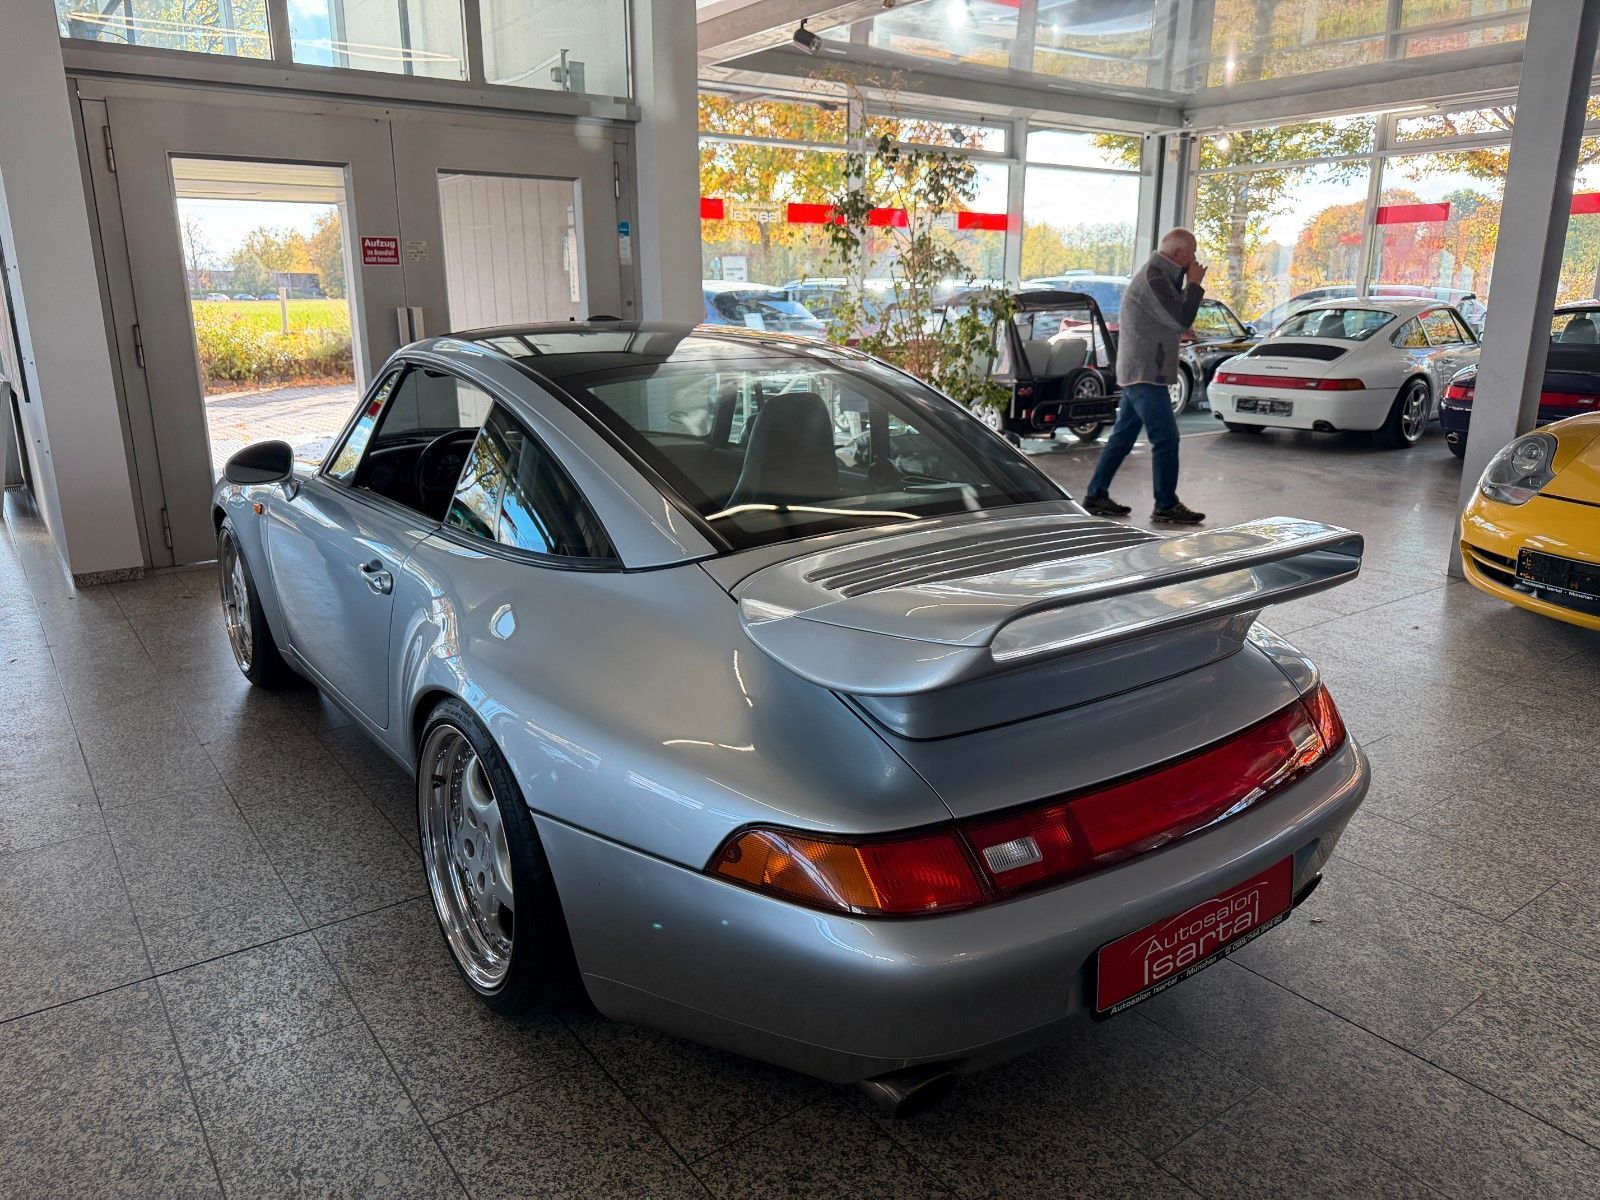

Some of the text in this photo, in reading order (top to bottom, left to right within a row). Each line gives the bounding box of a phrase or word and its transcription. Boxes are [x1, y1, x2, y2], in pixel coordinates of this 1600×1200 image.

[364, 238, 396, 249] Aufzug
[1521, 580, 1594, 600] Autosalon Isartal München
[1144, 900, 1260, 986] Isartal
[1145, 890, 1259, 959] Autosalon
[1110, 991, 1151, 1015] Autosalon
[1153, 977, 1178, 994] Isartal
[1186, 956, 1217, 977] München
